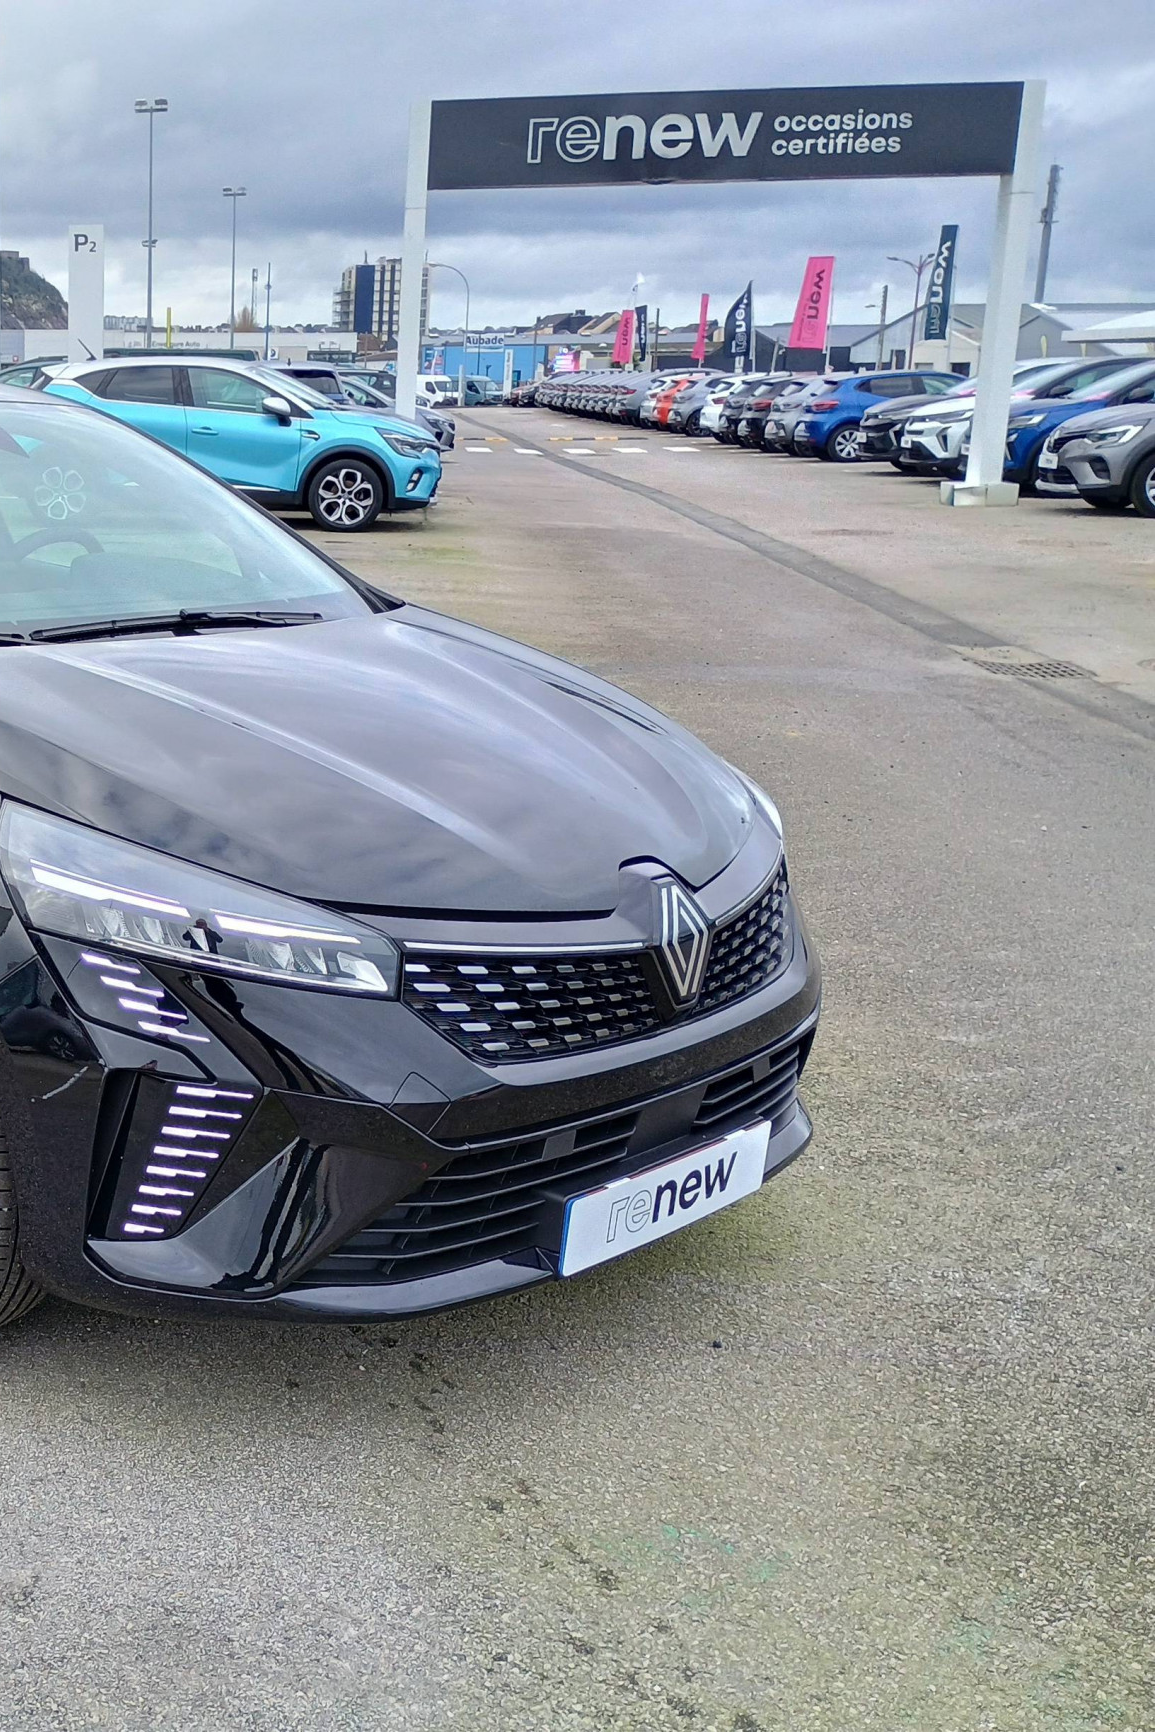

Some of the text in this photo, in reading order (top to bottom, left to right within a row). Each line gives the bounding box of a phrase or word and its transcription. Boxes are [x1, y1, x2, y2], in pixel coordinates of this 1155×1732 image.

[773, 109, 913, 133] occasions
[526, 112, 763, 164] renew
[771, 132, 902, 156] certifiées
[466, 335, 504, 345] Aubade
[606, 1151, 738, 1243] renew
